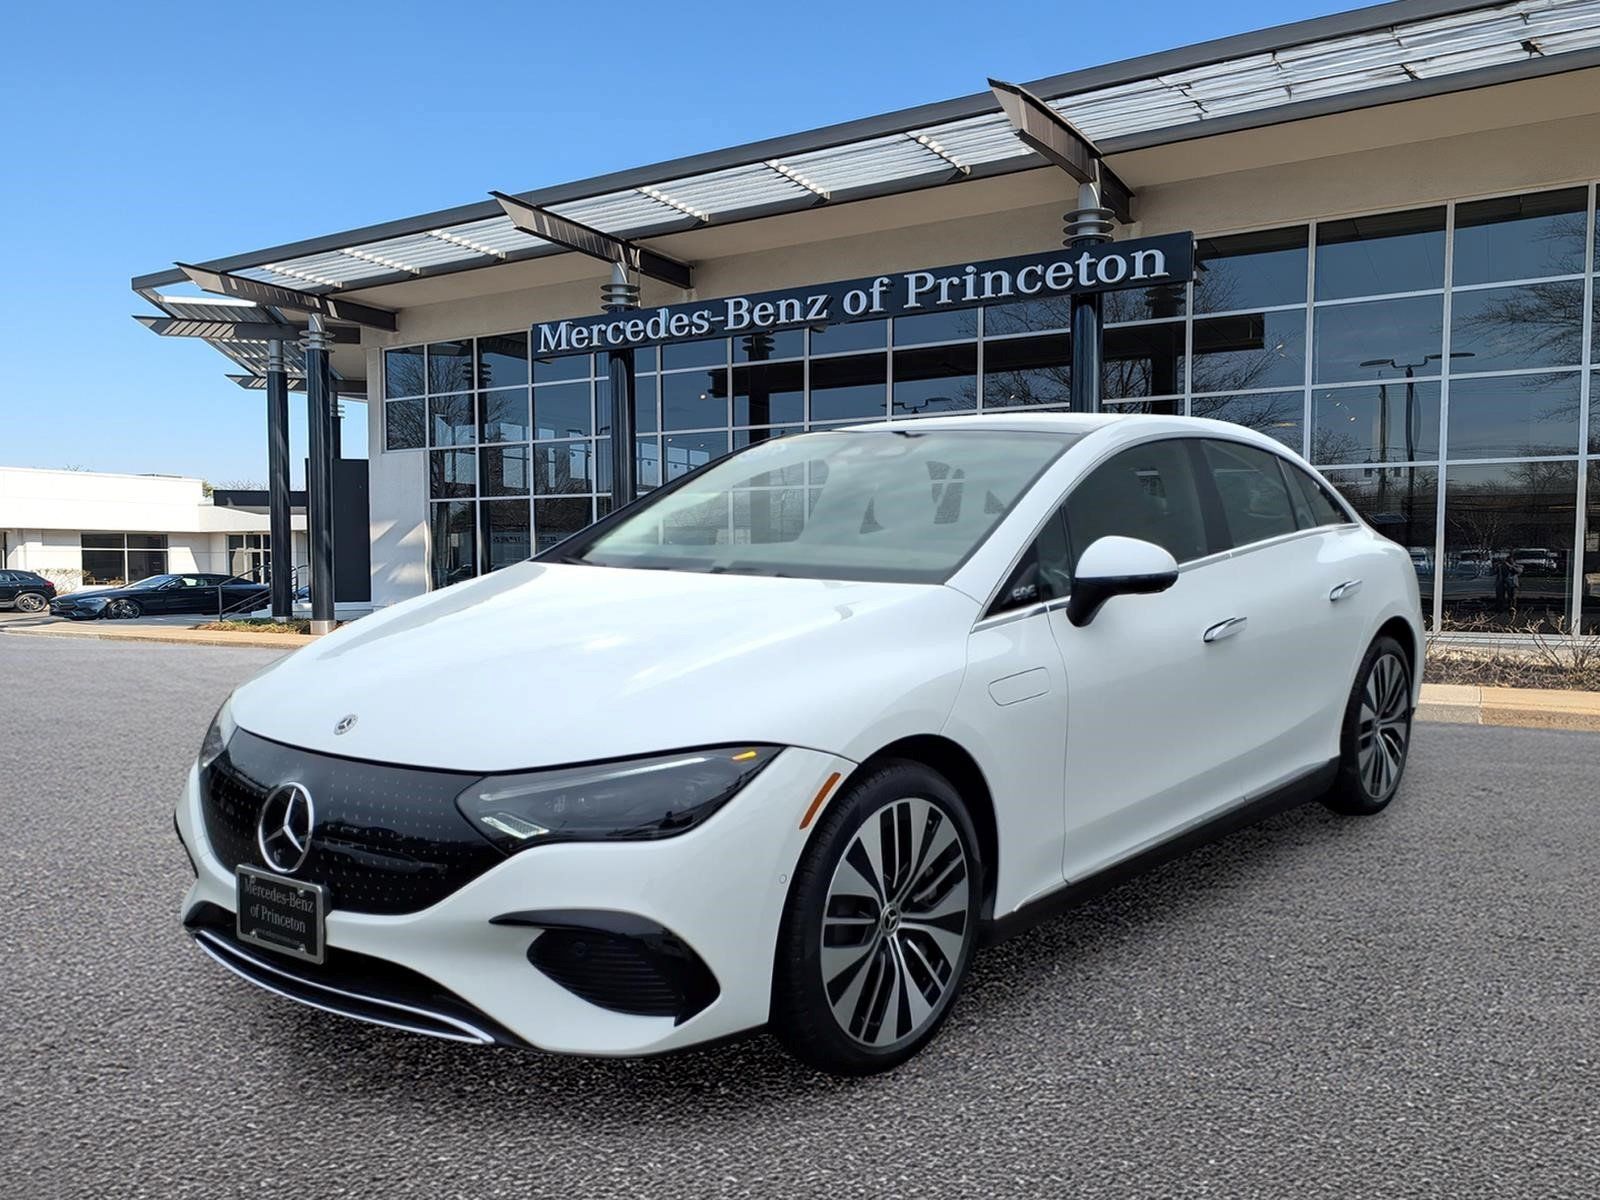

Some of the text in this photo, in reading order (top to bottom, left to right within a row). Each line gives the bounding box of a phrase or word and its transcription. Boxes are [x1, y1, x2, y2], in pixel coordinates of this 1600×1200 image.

[537, 247, 1170, 353] Mercedes-Benz of Princeton
[244, 877, 314, 914] Mercedes-Benz
[250, 903, 306, 934] of Princeton
